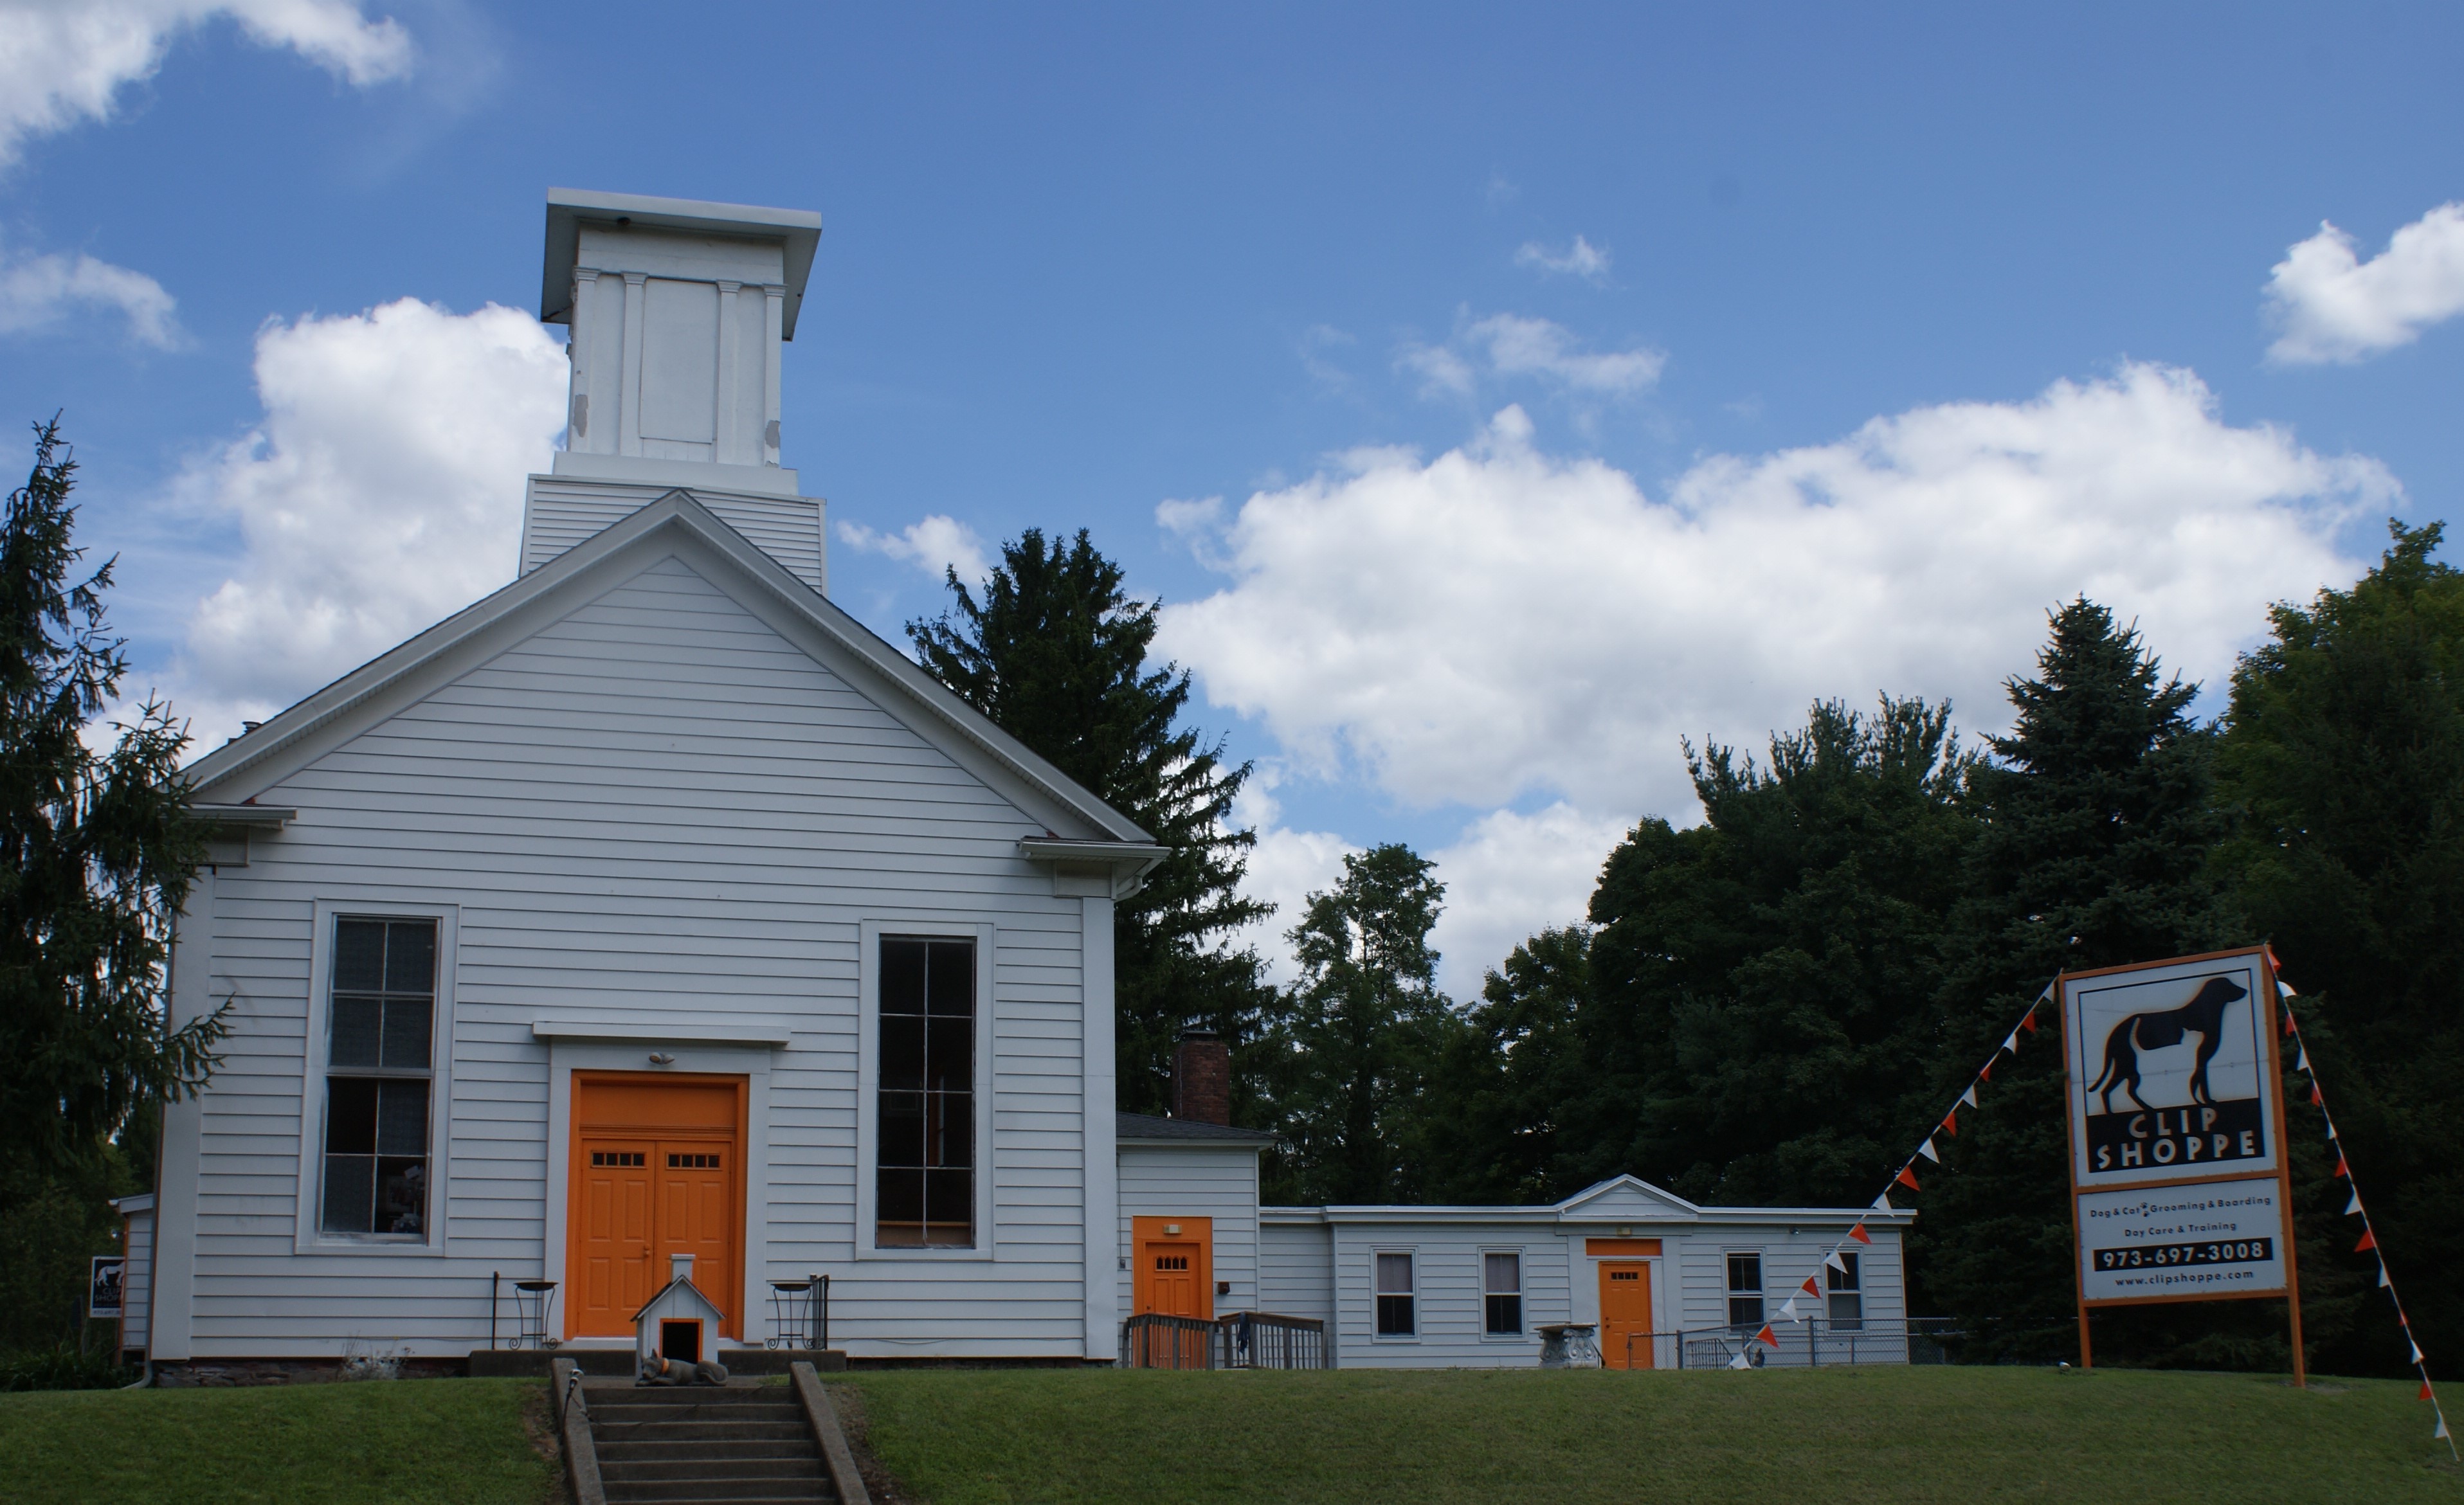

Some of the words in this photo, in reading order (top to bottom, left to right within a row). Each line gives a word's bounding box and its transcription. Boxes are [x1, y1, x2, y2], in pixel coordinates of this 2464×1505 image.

[2128, 1107, 2216, 1138] CLIP
[2096, 1130, 2256, 1169] SHOPPE
[2090, 1209, 2111, 1218] Dog
[2113, 1208, 2120, 1216] &
[2122, 1207, 2140, 1215] Cat
[2150, 1202, 2206, 1212] Grooming
[2217, 1196, 2271, 1207] Boarding
[2124, 1229, 2145, 1238] Day
[2148, 1227, 2173, 1235] Care
[2177, 1225, 2184, 1233] &
[2188, 1222, 2236, 1231] Training
[2102, 1241, 2264, 1268] 973-697-3008
[2114, 1271, 2254, 1286] www.clipshoppe.com
